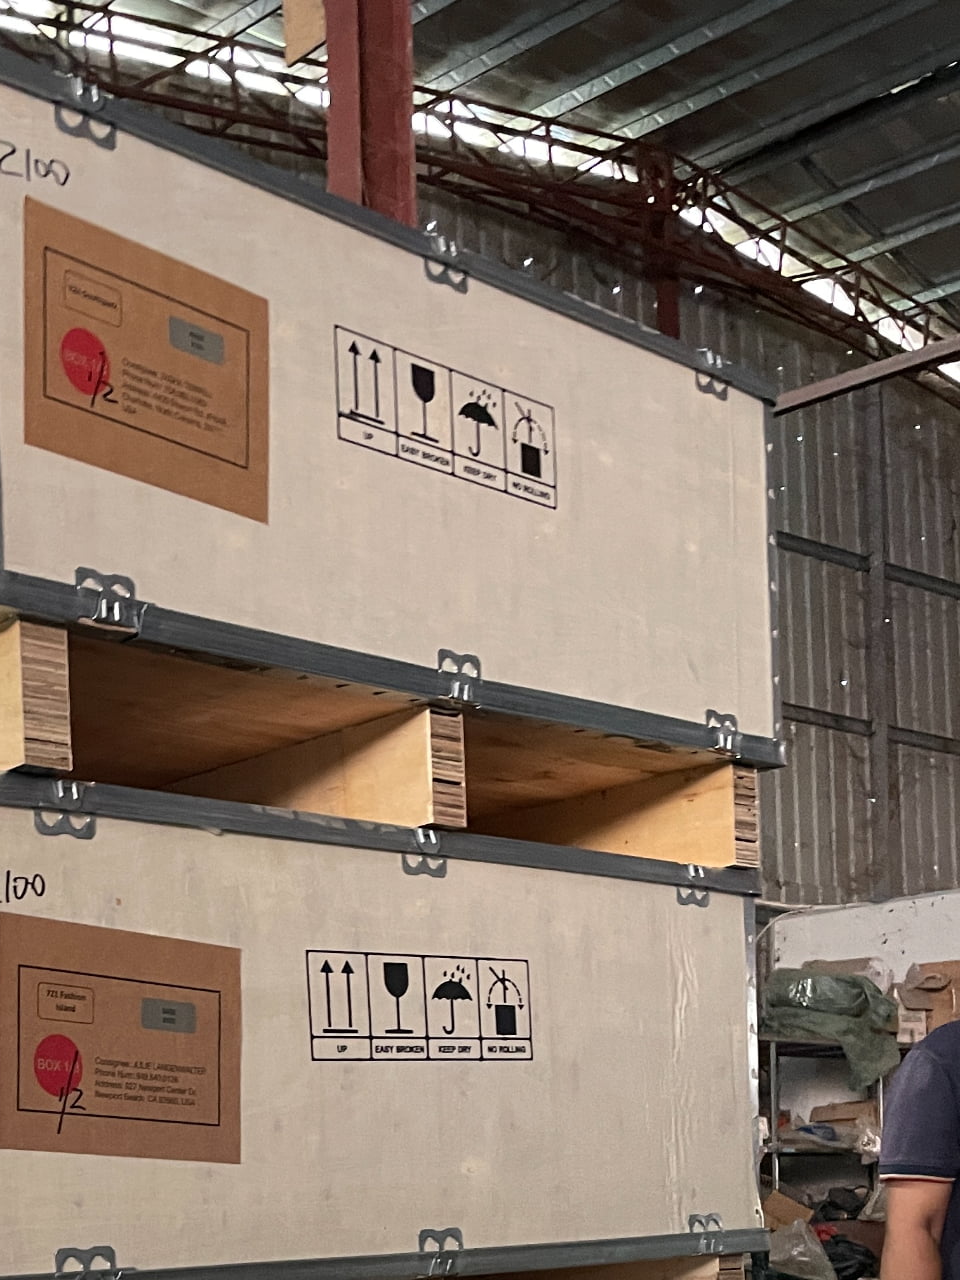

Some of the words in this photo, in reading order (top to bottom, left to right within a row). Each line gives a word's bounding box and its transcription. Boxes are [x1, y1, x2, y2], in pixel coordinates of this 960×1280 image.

[337, 1044, 348, 1053] UP
[375, 1044, 395, 1054] EASY
[396, 1044, 425, 1054] BROKEN
[438, 1044, 455, 1054] KEEP
[457, 1044, 472, 1054] DRY
[487, 1044, 497, 1054] NO
[498, 1044, 527, 1054] ROLLING
[37, 1057, 62, 1071] BOX
